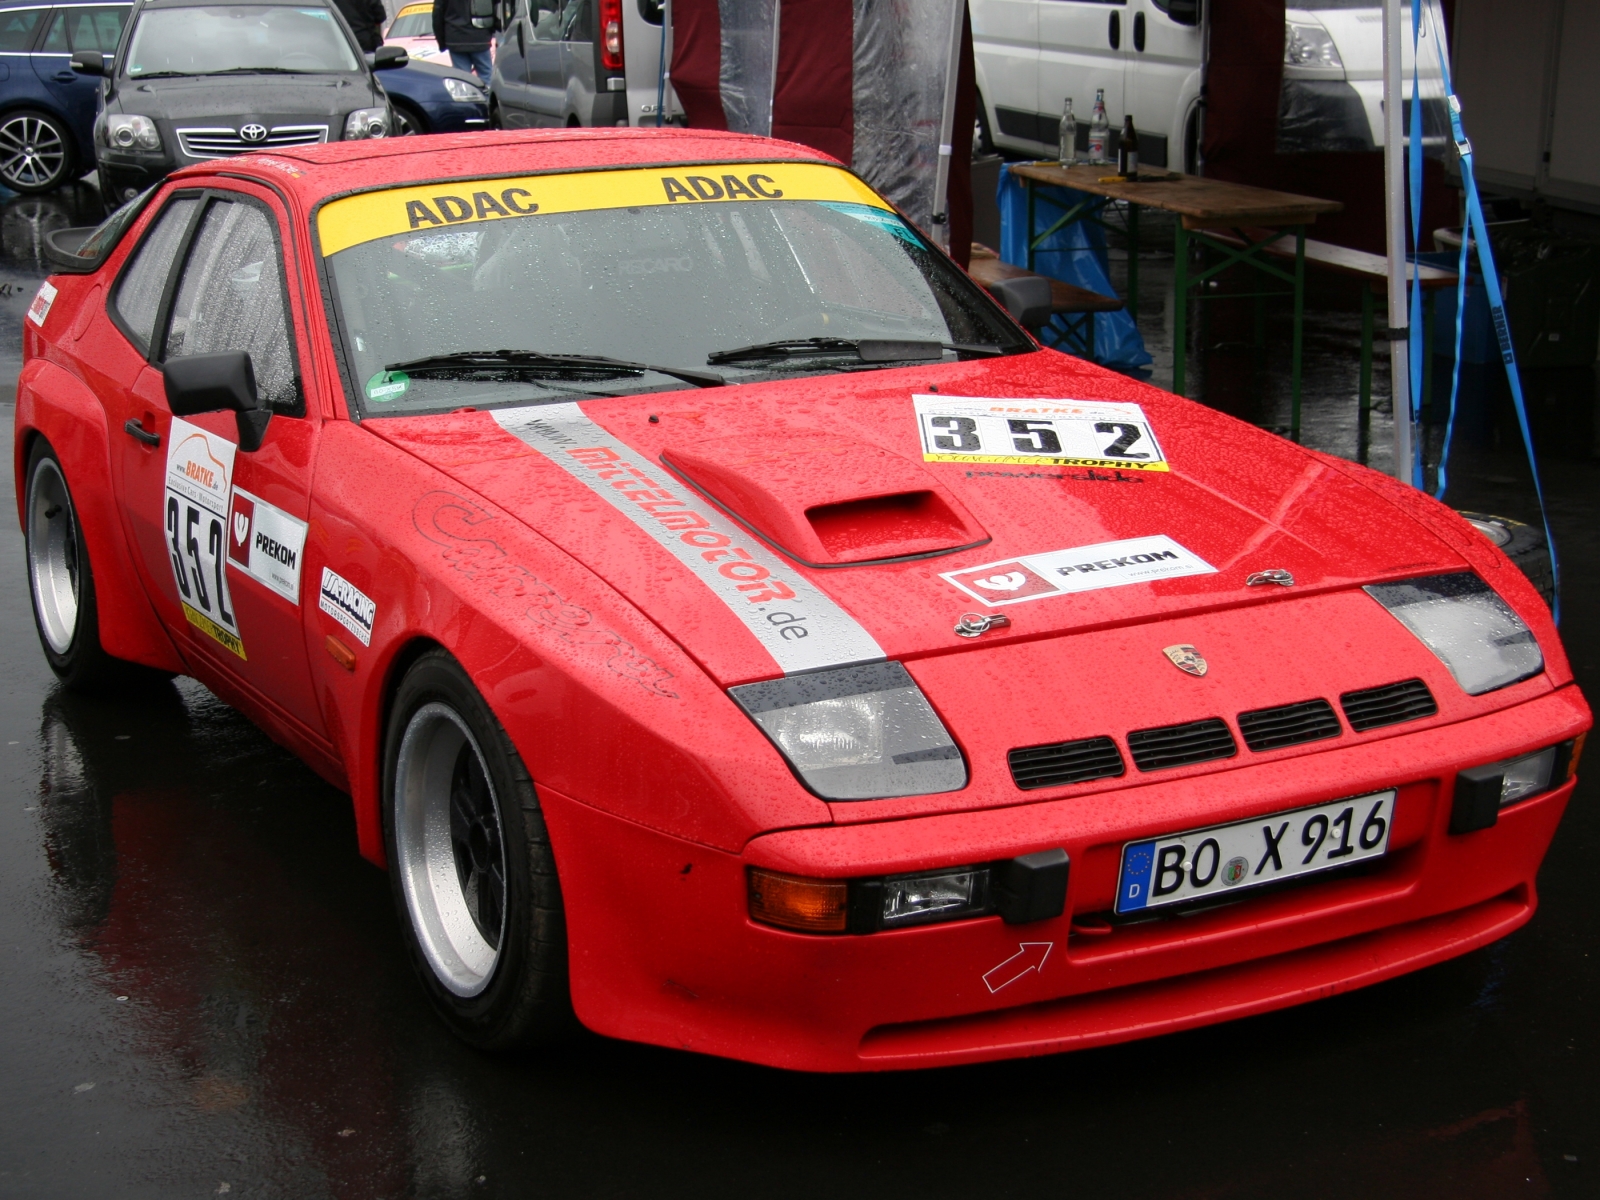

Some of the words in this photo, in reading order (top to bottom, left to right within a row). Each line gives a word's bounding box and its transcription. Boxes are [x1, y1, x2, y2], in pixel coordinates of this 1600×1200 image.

[405, 188, 539, 229] ADAC
[661, 174, 784, 202] ADAC
[1491, 304, 1512, 351] BERNER
[168, 496, 234, 627] 352
[256, 531, 296, 570] PREKOM
[1055, 550, 1180, 577] PREKOM
[1152, 838, 1220, 897] BO
[1254, 821, 1289, 876] X
[1301, 800, 1386, 865] 916
[1129, 884, 1141, 899] D
